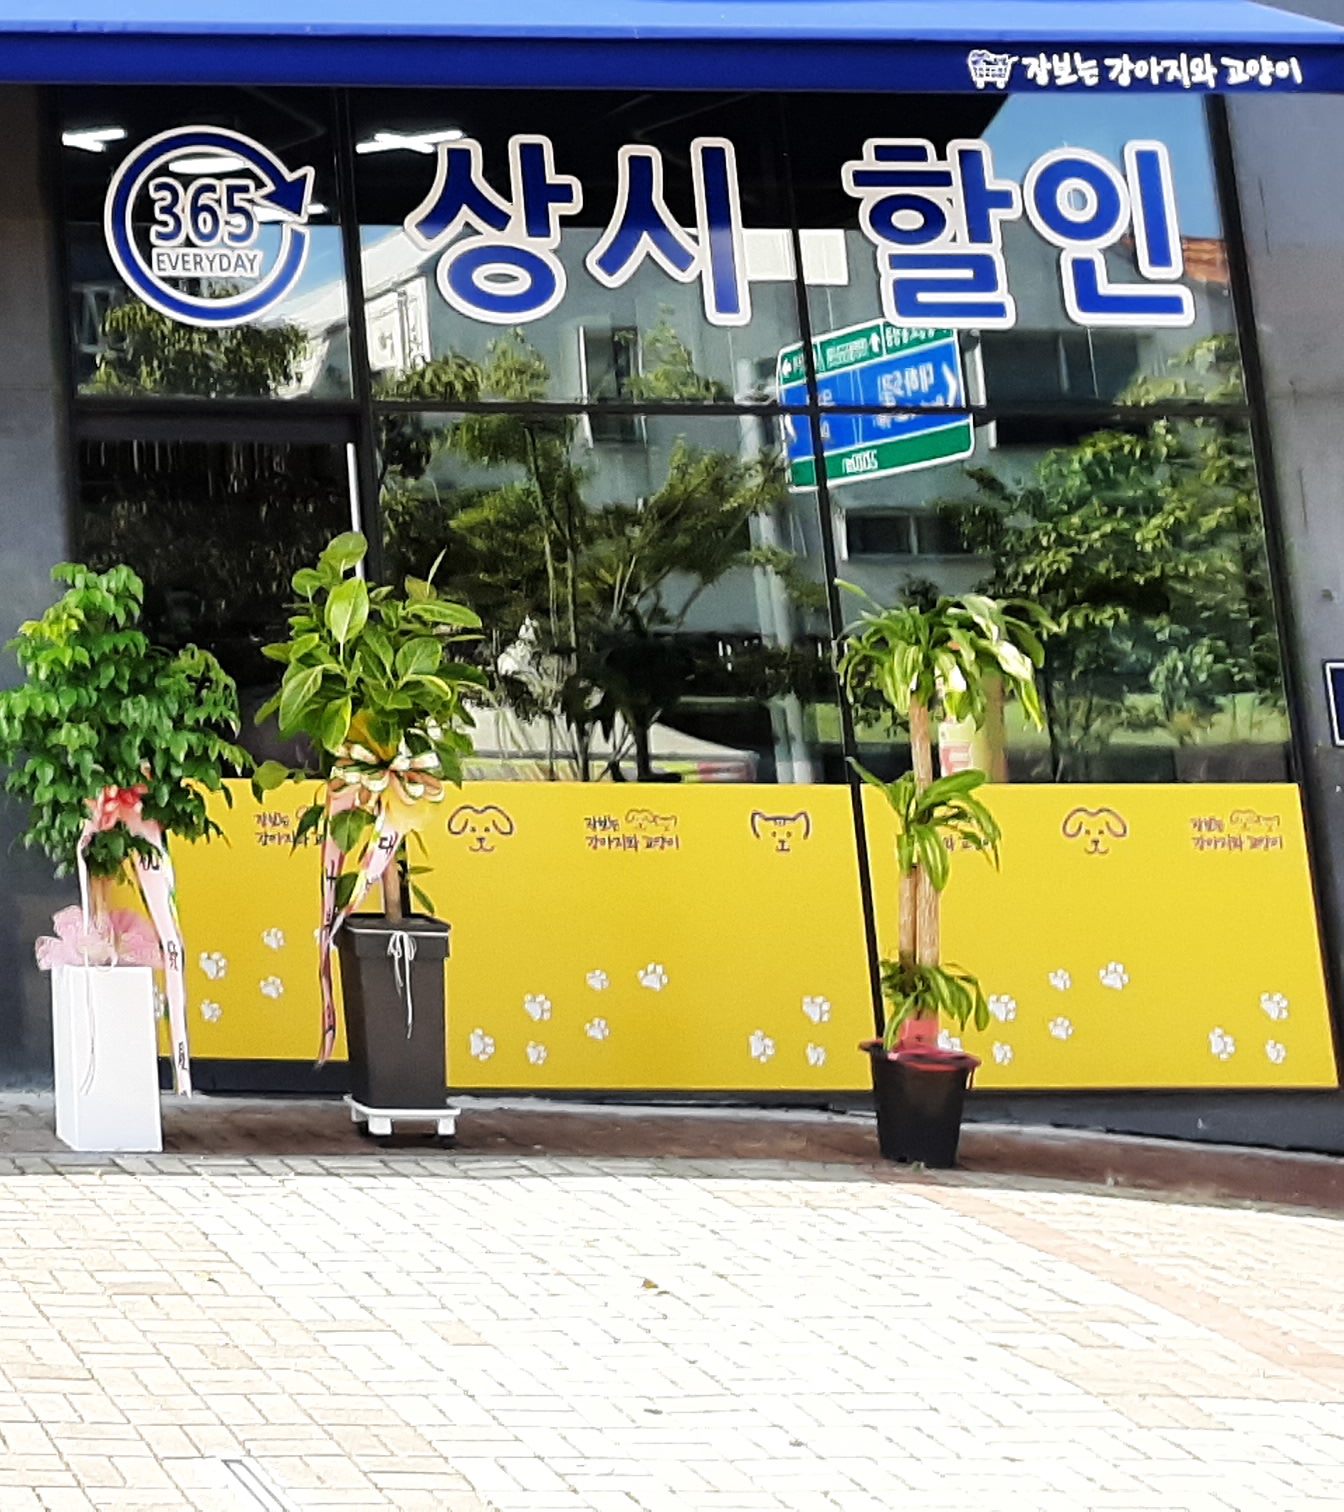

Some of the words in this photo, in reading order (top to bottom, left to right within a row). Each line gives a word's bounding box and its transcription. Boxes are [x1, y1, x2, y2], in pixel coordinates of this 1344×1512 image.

[1021, 52, 1099, 86] 장보는
[1104, 53, 1218, 89] 강아지와
[1220, 56, 1303, 85] 고양이
[149, 177, 256, 247] 365
[405, 134, 752, 325] 상시
[842, 138, 1195, 329] 할인
[152, 247, 261, 278] EVERYDAY
